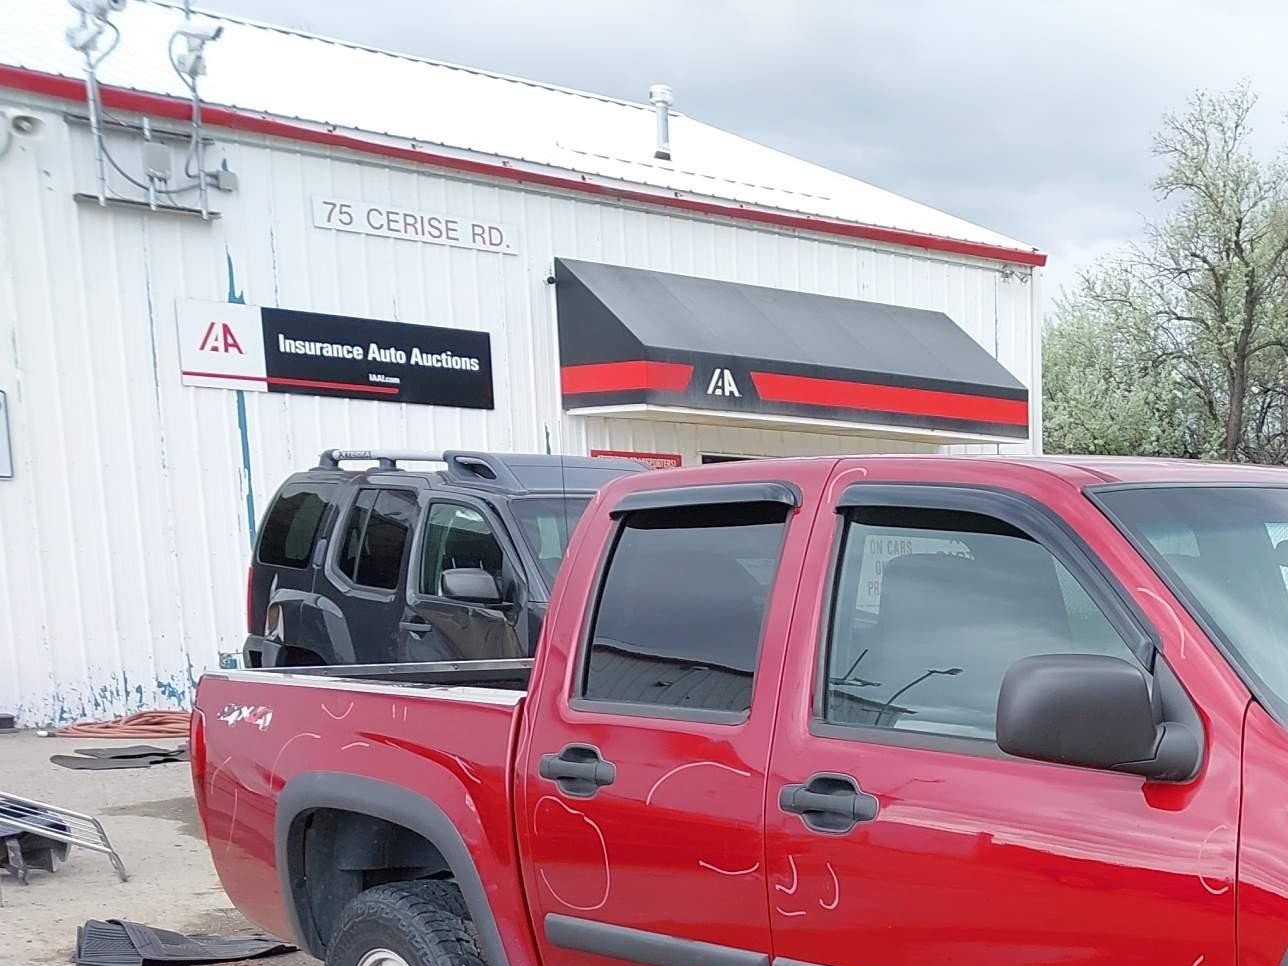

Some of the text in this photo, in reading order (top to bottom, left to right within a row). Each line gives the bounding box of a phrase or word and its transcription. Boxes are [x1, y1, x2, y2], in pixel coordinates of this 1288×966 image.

[322, 201, 510, 249] 75 CERISE RD.
[278, 333, 480, 371] Insurance Auto Auctions
